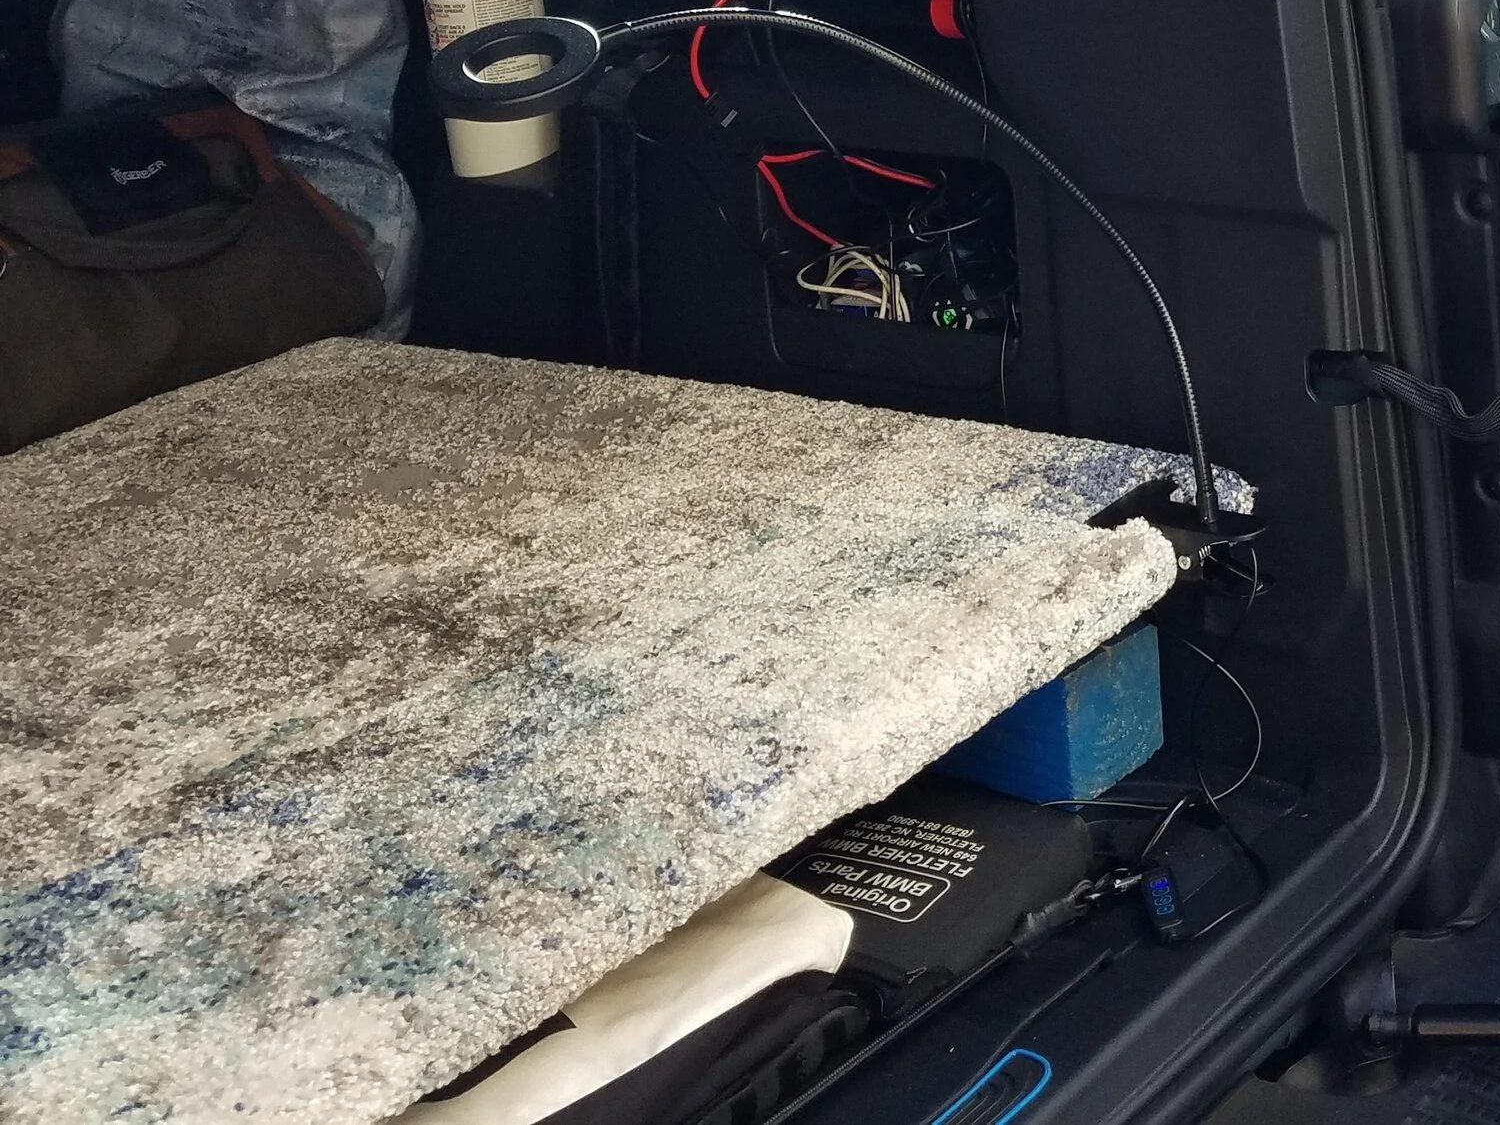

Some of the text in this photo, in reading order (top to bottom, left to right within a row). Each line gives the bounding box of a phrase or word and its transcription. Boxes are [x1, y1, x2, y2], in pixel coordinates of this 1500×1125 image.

[887, 814, 975, 837] (828) 681-9900
[891, 826, 912, 836] NC
[862, 831, 918, 851] AIRPORT
[914, 828, 985, 852] FLETCHER,
[918, 842, 951, 857] NEW
[815, 837, 975, 878] FLETCHER BMW
[952, 850, 978, 862] 649
[808, 860, 934, 897] BMW Parts
[821, 882, 912, 913] Original
